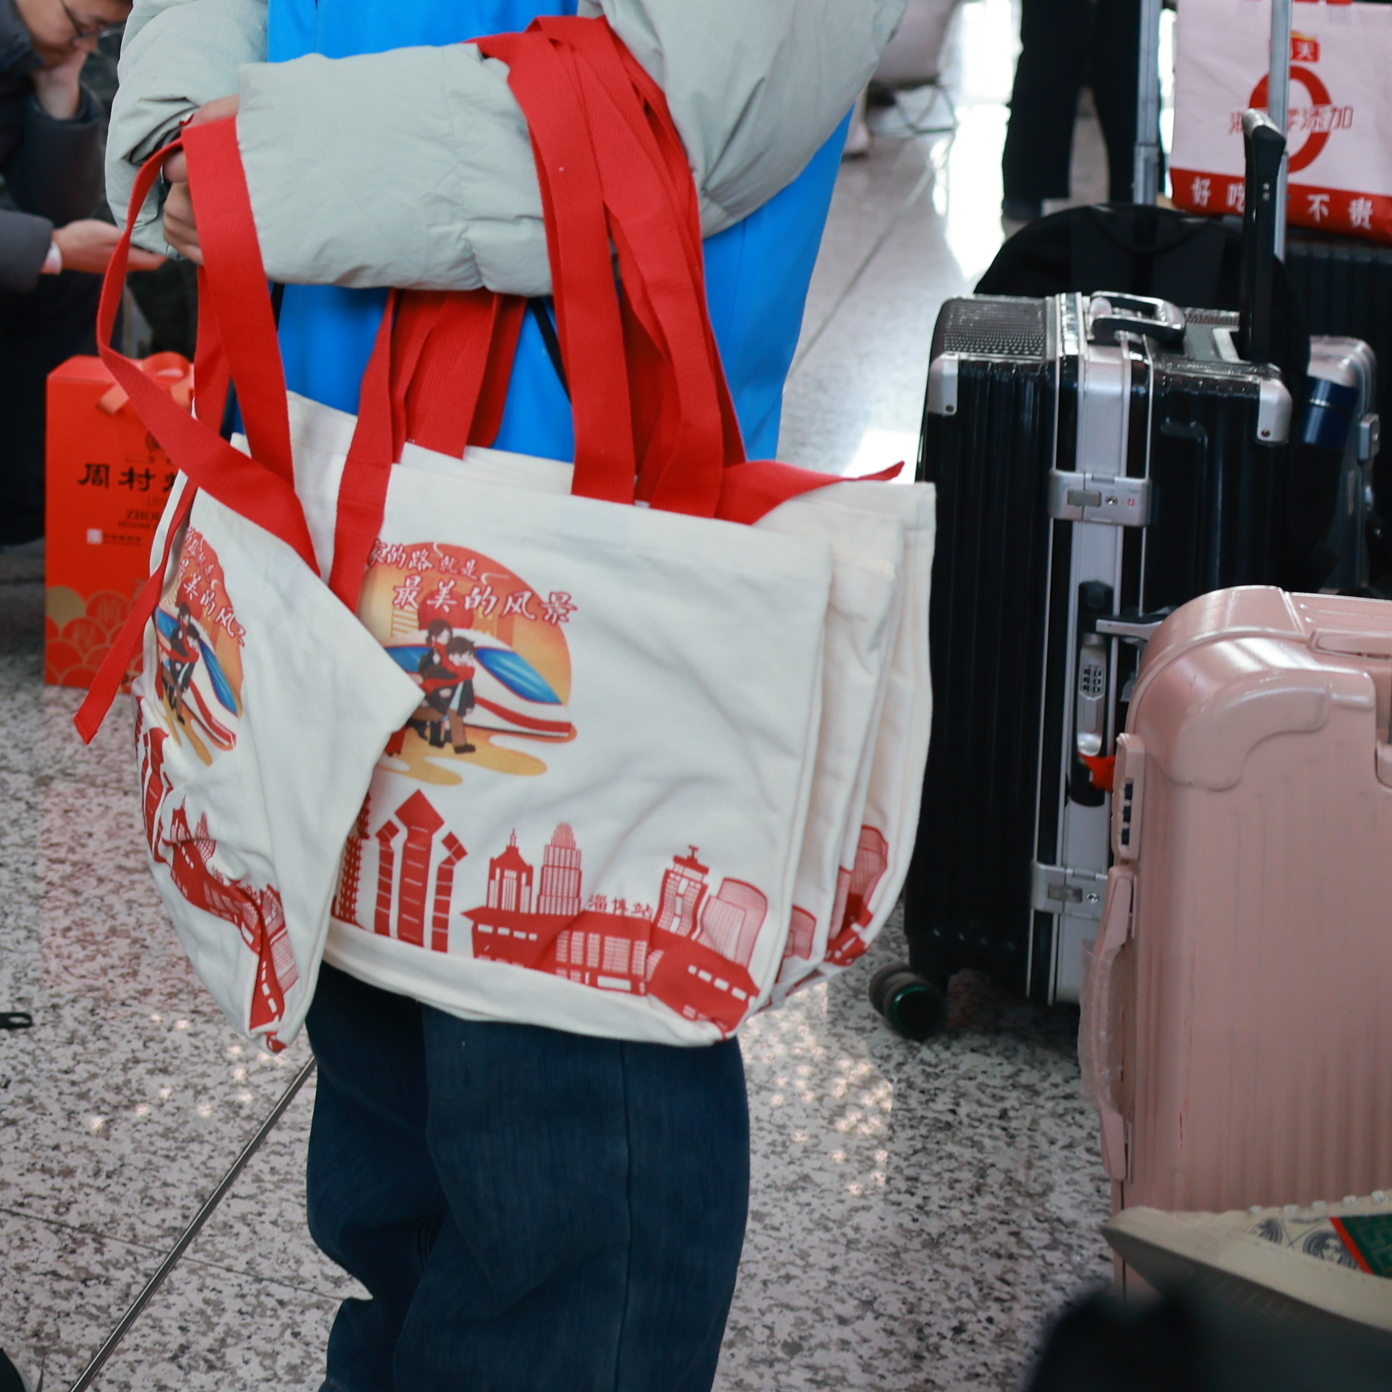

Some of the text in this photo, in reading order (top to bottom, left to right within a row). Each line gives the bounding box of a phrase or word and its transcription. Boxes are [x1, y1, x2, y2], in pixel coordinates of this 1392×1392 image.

[1191, 177, 1374, 229] 好吃不贵
[393, 575, 578, 625] 最美的风景
[588, 894, 654, 920] 淄博站
